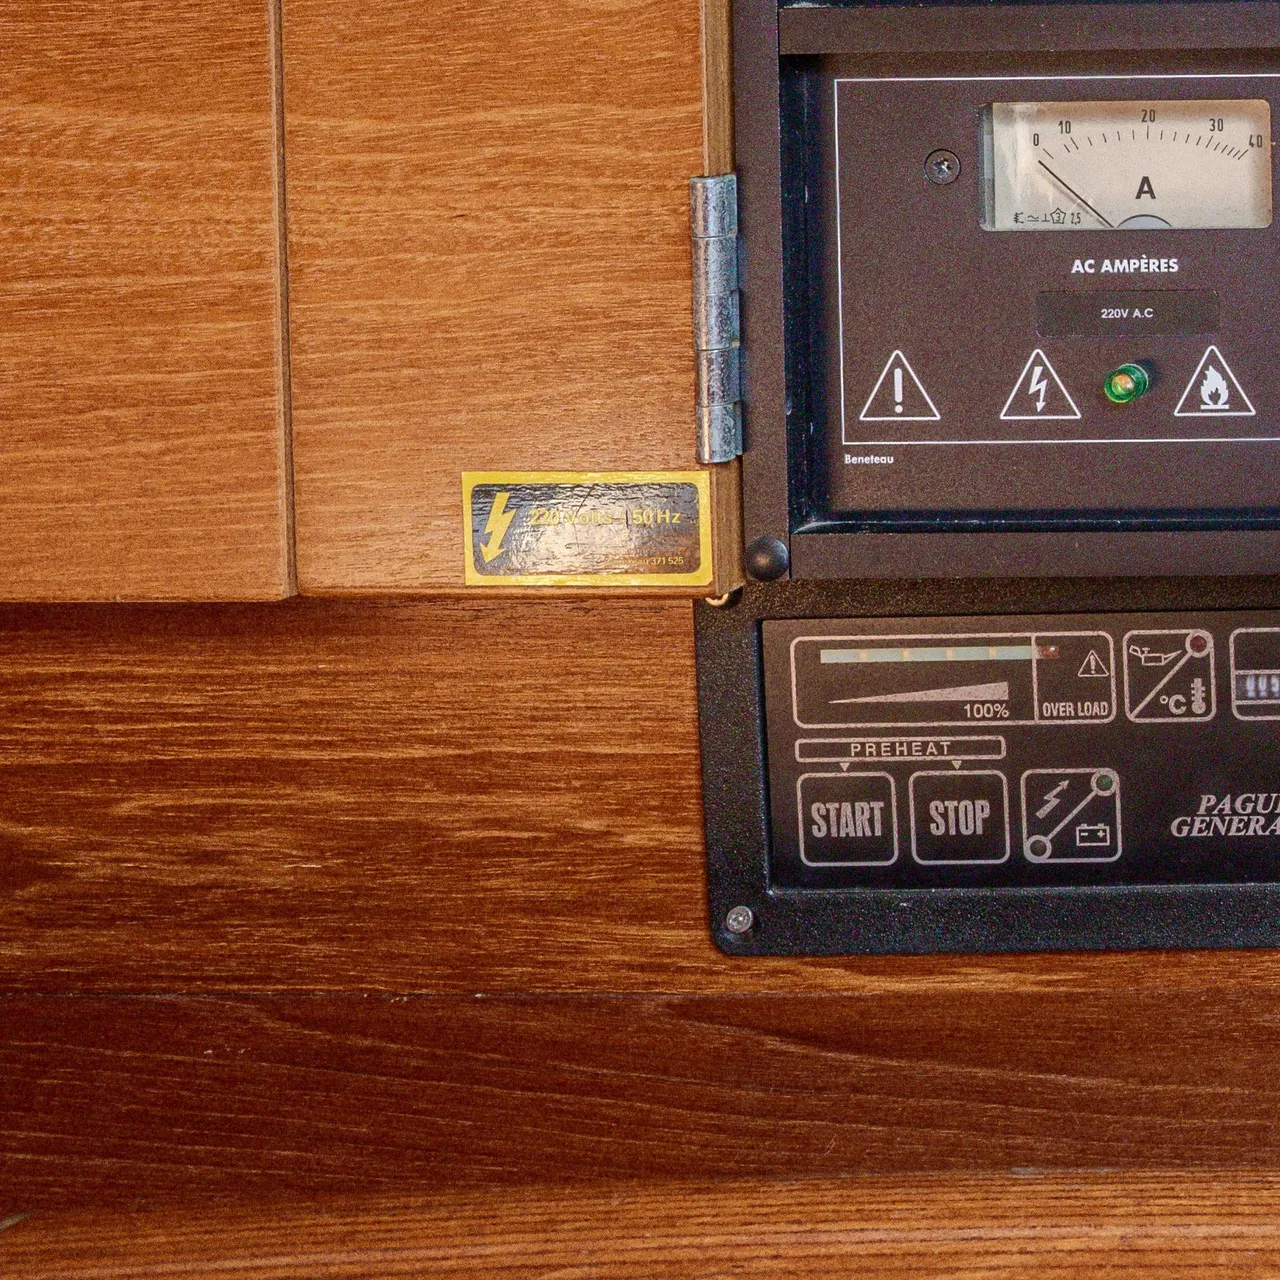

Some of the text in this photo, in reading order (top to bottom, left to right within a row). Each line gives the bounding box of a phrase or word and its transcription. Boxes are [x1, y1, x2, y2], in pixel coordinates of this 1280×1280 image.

[1141, 109, 1156, 122] 20
[1058, 121, 1071, 134] 10
[1210, 119, 1224, 132] 30
[1248, 135, 1263, 148] 40
[1135, 177, 1157, 199] A
[1071, 254, 1179, 273] AC AMPÈRES
[1101, 307, 1153, 319] 220V A.C
[845, 454, 894, 465] Beneteau
[531, 510, 559, 525] 220
[633, 509, 652, 524] 50
[657, 509, 680, 524] Hz
[964, 703, 1009, 718] 100%
[1043, 702, 1108, 716] OVER LOAD
[851, 743, 951, 756] PREHEAT
[812, 801, 883, 838] START
[930, 800, 989, 836] STOP
